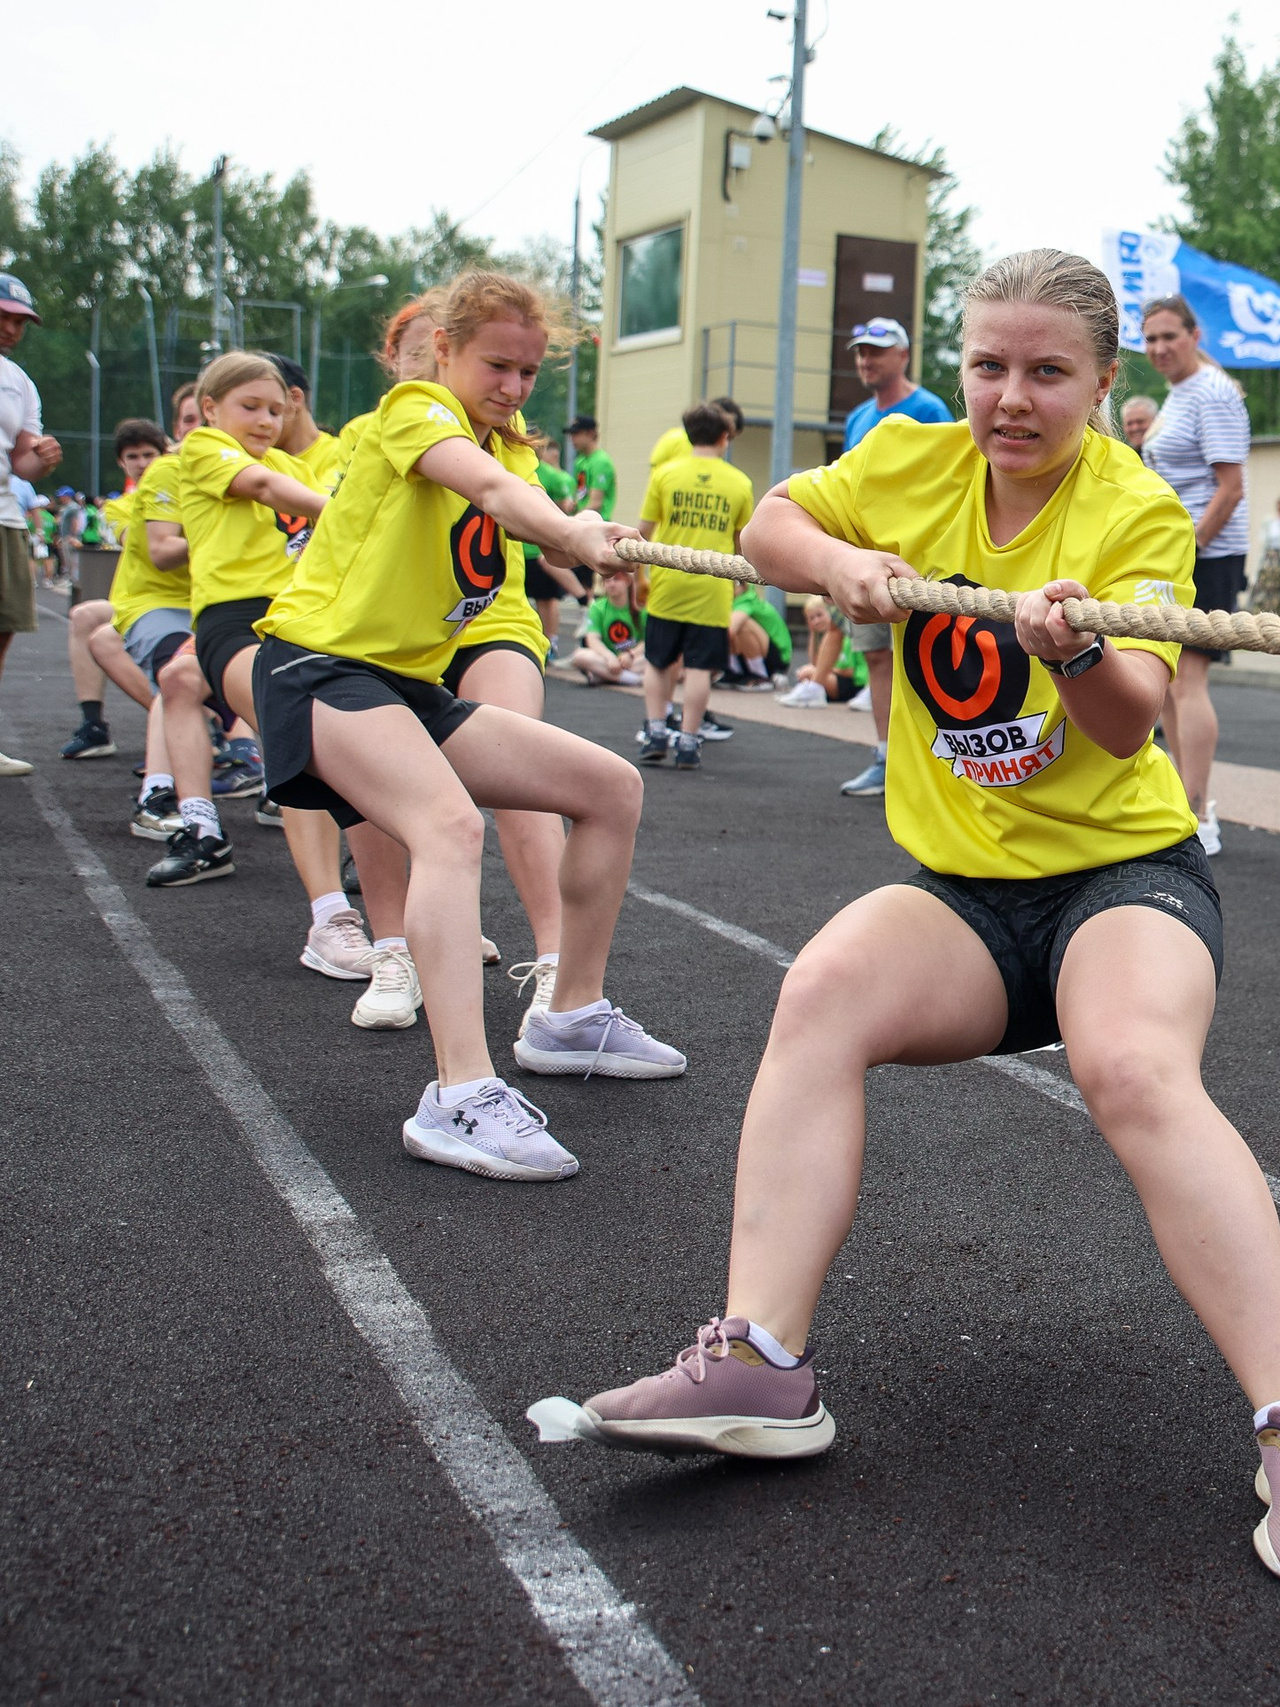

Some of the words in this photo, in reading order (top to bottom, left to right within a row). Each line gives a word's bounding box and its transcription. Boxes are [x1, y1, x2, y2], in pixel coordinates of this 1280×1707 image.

[673, 491, 730, 513] ЮНОСТЬ
[670, 511, 730, 532] МОСКВЫ
[943, 726, 1027, 756] ВЫЗОВ
[961, 740, 1055, 783] ПРИНЯТ
